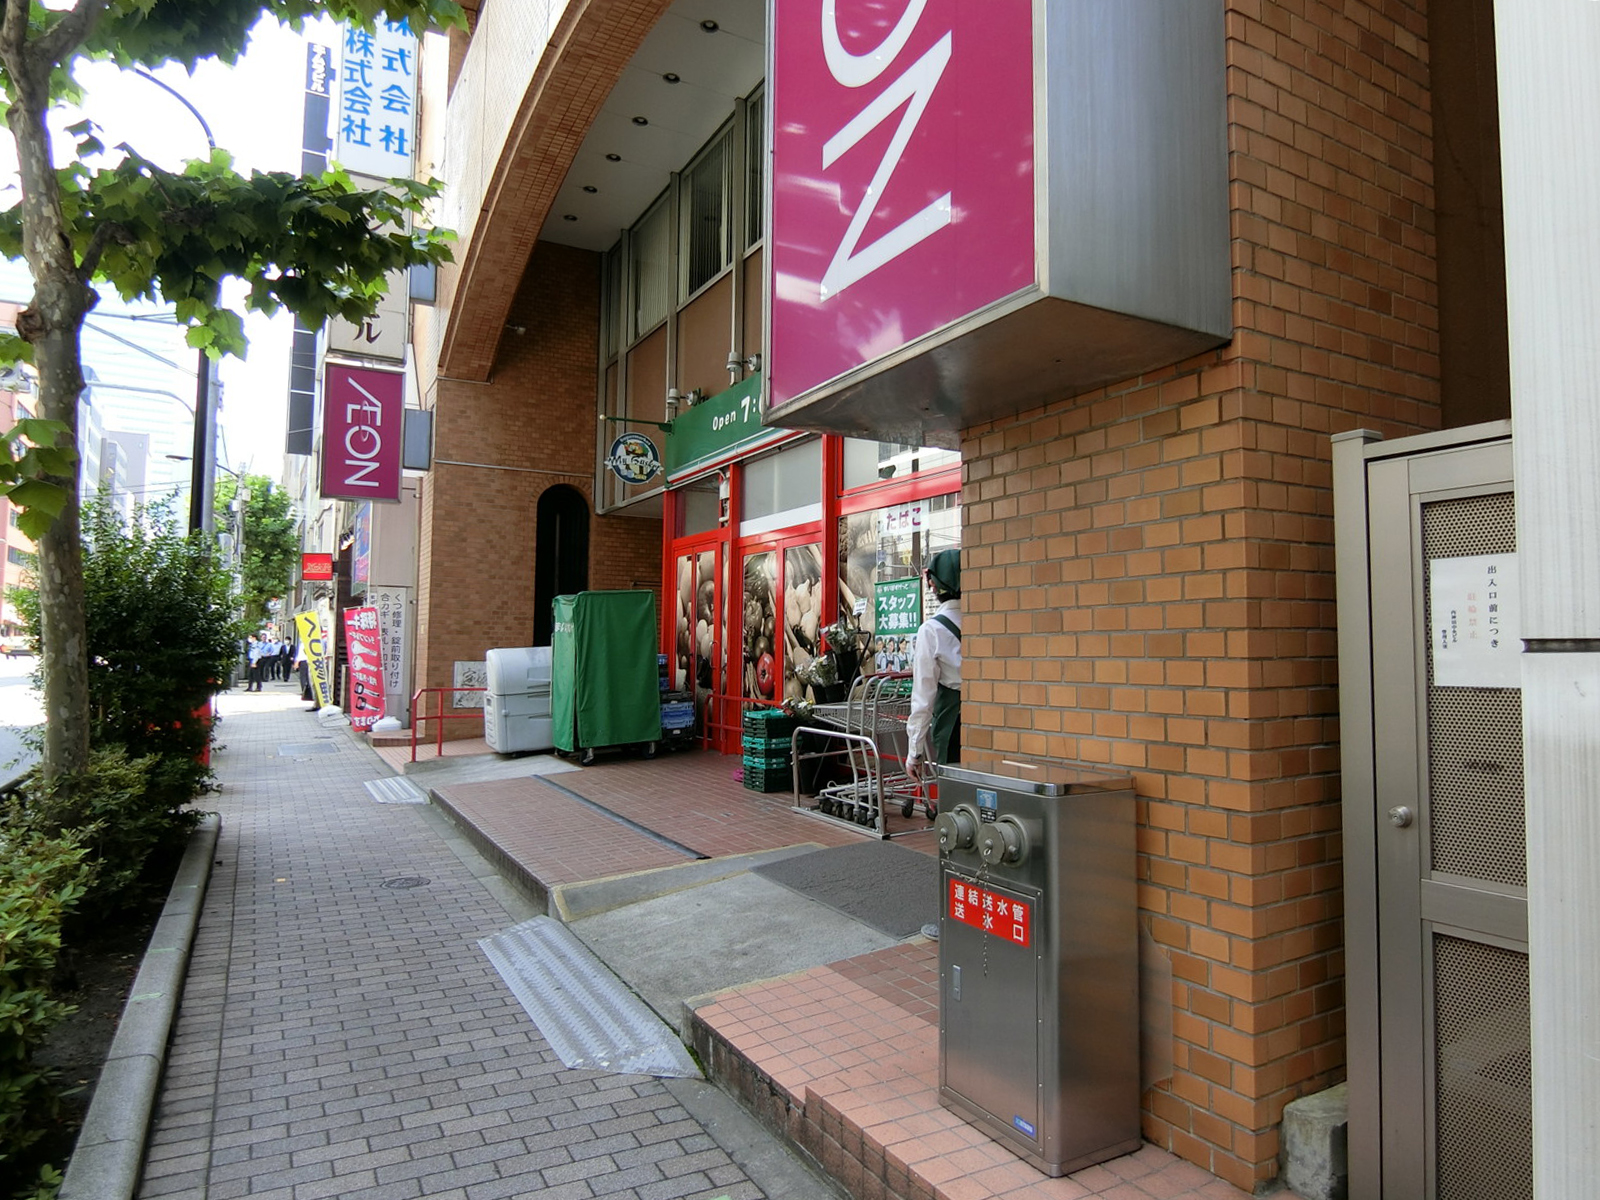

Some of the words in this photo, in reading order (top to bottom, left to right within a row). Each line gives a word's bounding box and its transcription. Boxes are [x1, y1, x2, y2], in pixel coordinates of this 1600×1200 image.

[342, 28, 375, 148] 株式会社
[344, 376, 383, 488] AEON
[712, 411, 737, 431] Open
[608, 455, 628, 466] My
[886, 507, 922, 531] たばこ
[878, 593, 916, 611] スタッフ
[1487, 565, 1499, 648] 出入口前につき
[878, 611, 917, 630] 大募集!!
[954, 883, 1025, 923] 連結送水管
[954, 902, 1025, 943] 送水口
